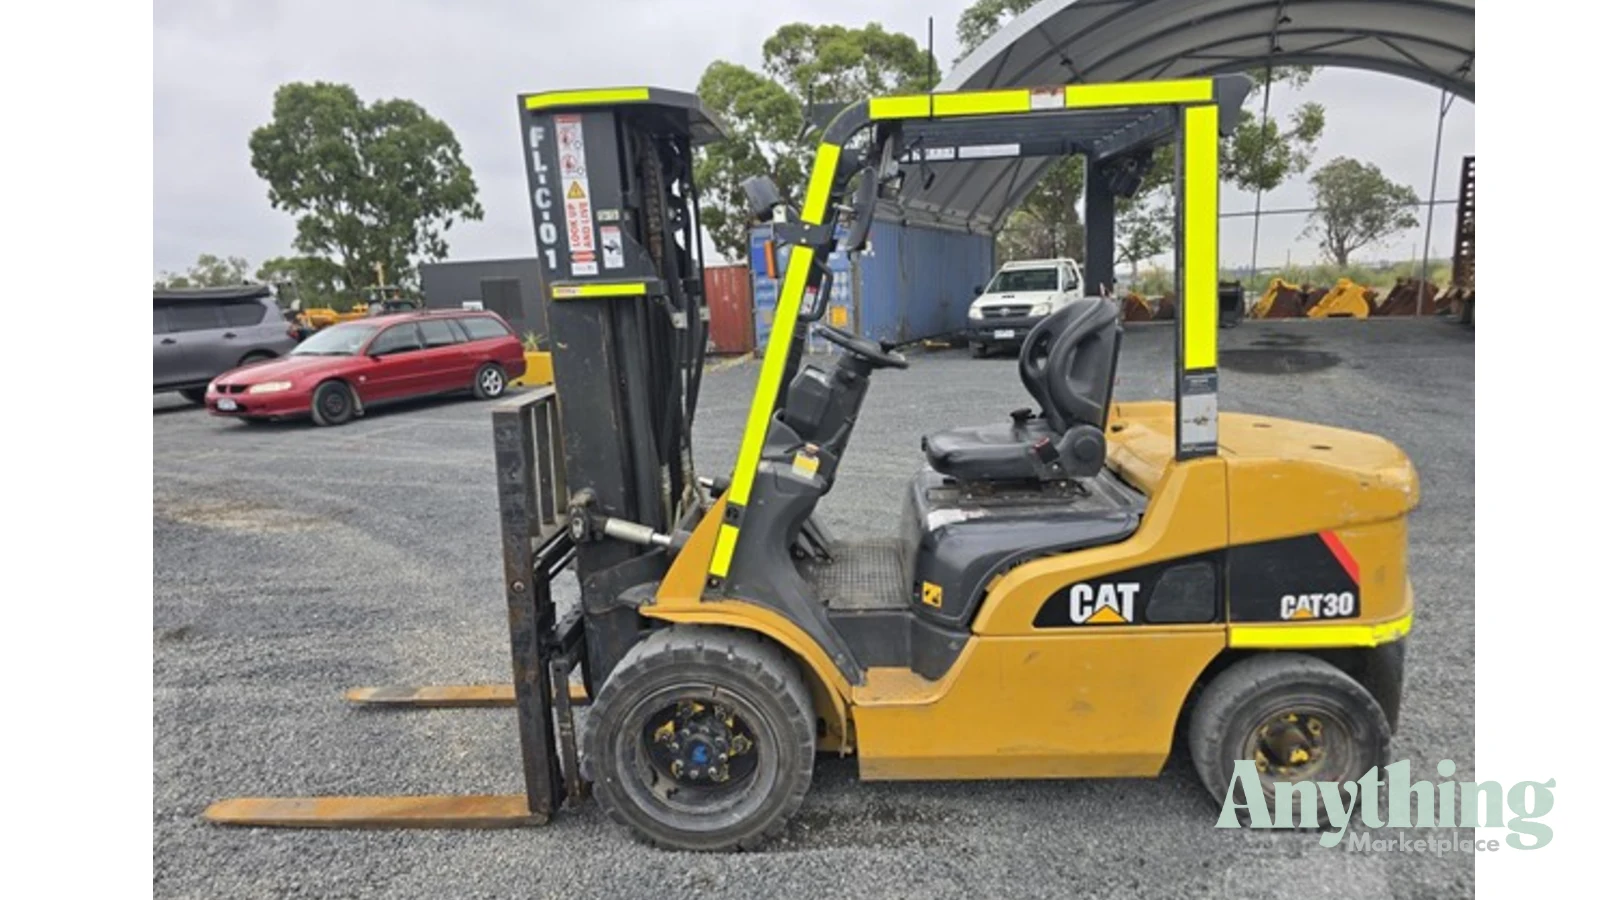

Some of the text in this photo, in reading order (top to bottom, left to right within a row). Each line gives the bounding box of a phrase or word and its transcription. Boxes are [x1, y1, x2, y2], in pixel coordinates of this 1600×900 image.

[570, 220, 580, 247] LOOK
[582, 226, 592, 248] AND
[1069, 583, 1140, 624] CAT
[1281, 591, 1355, 619] CAT30
